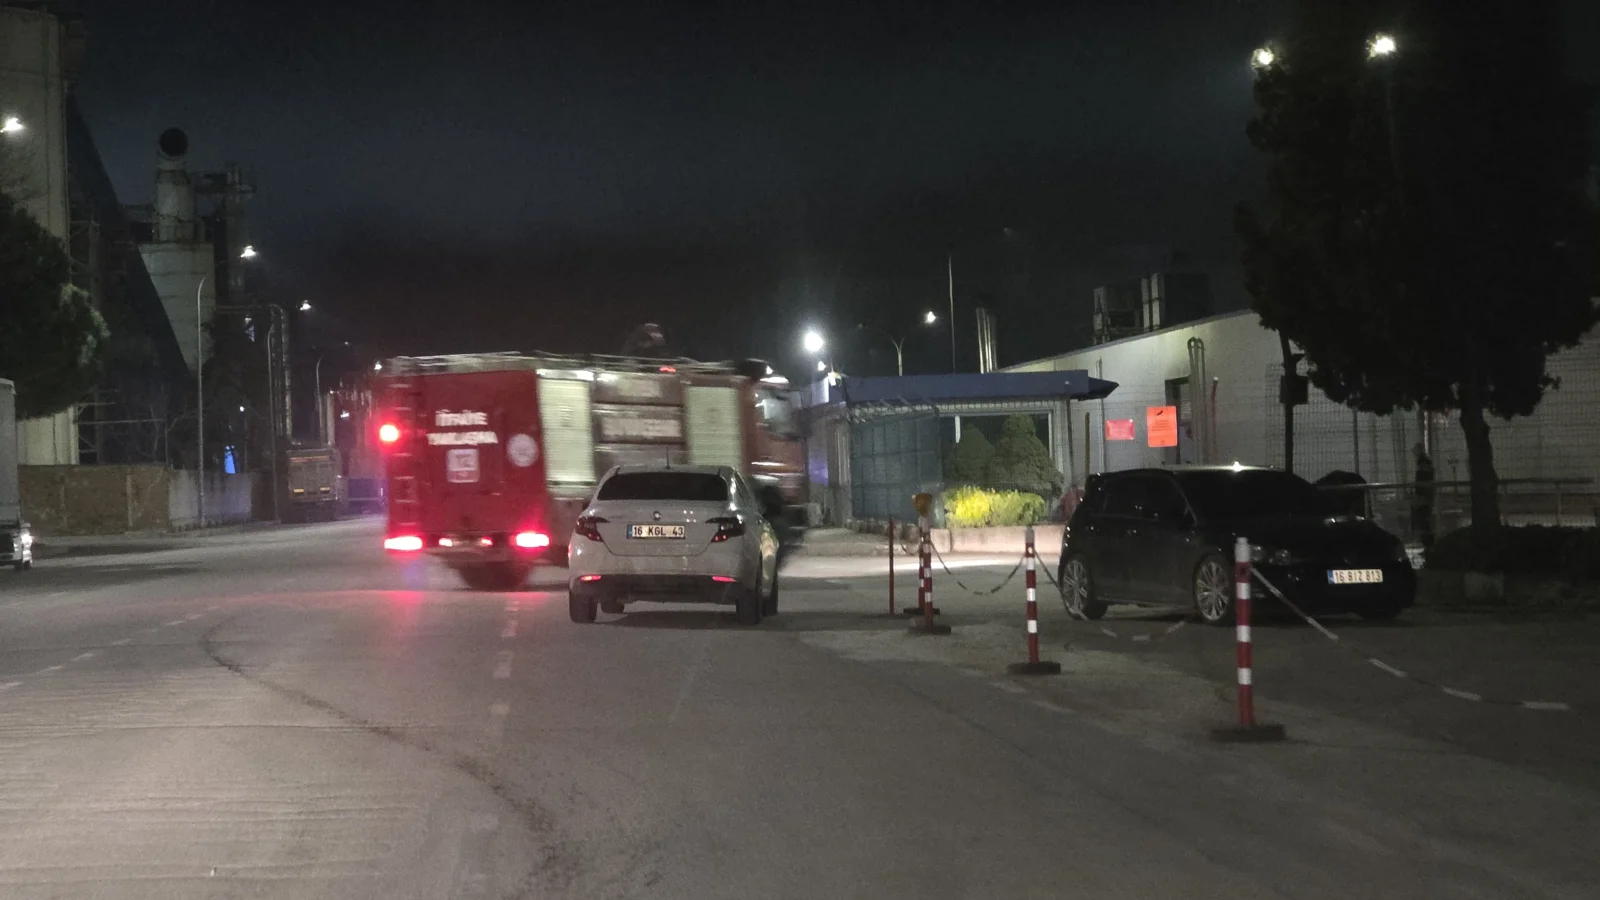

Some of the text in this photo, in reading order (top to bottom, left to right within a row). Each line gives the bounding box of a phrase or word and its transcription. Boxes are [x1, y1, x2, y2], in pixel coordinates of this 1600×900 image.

[633, 526, 684, 536] 16 KGL 43
[1335, 571, 1345, 583] 16
[1365, 570, 1381, 582] 813
